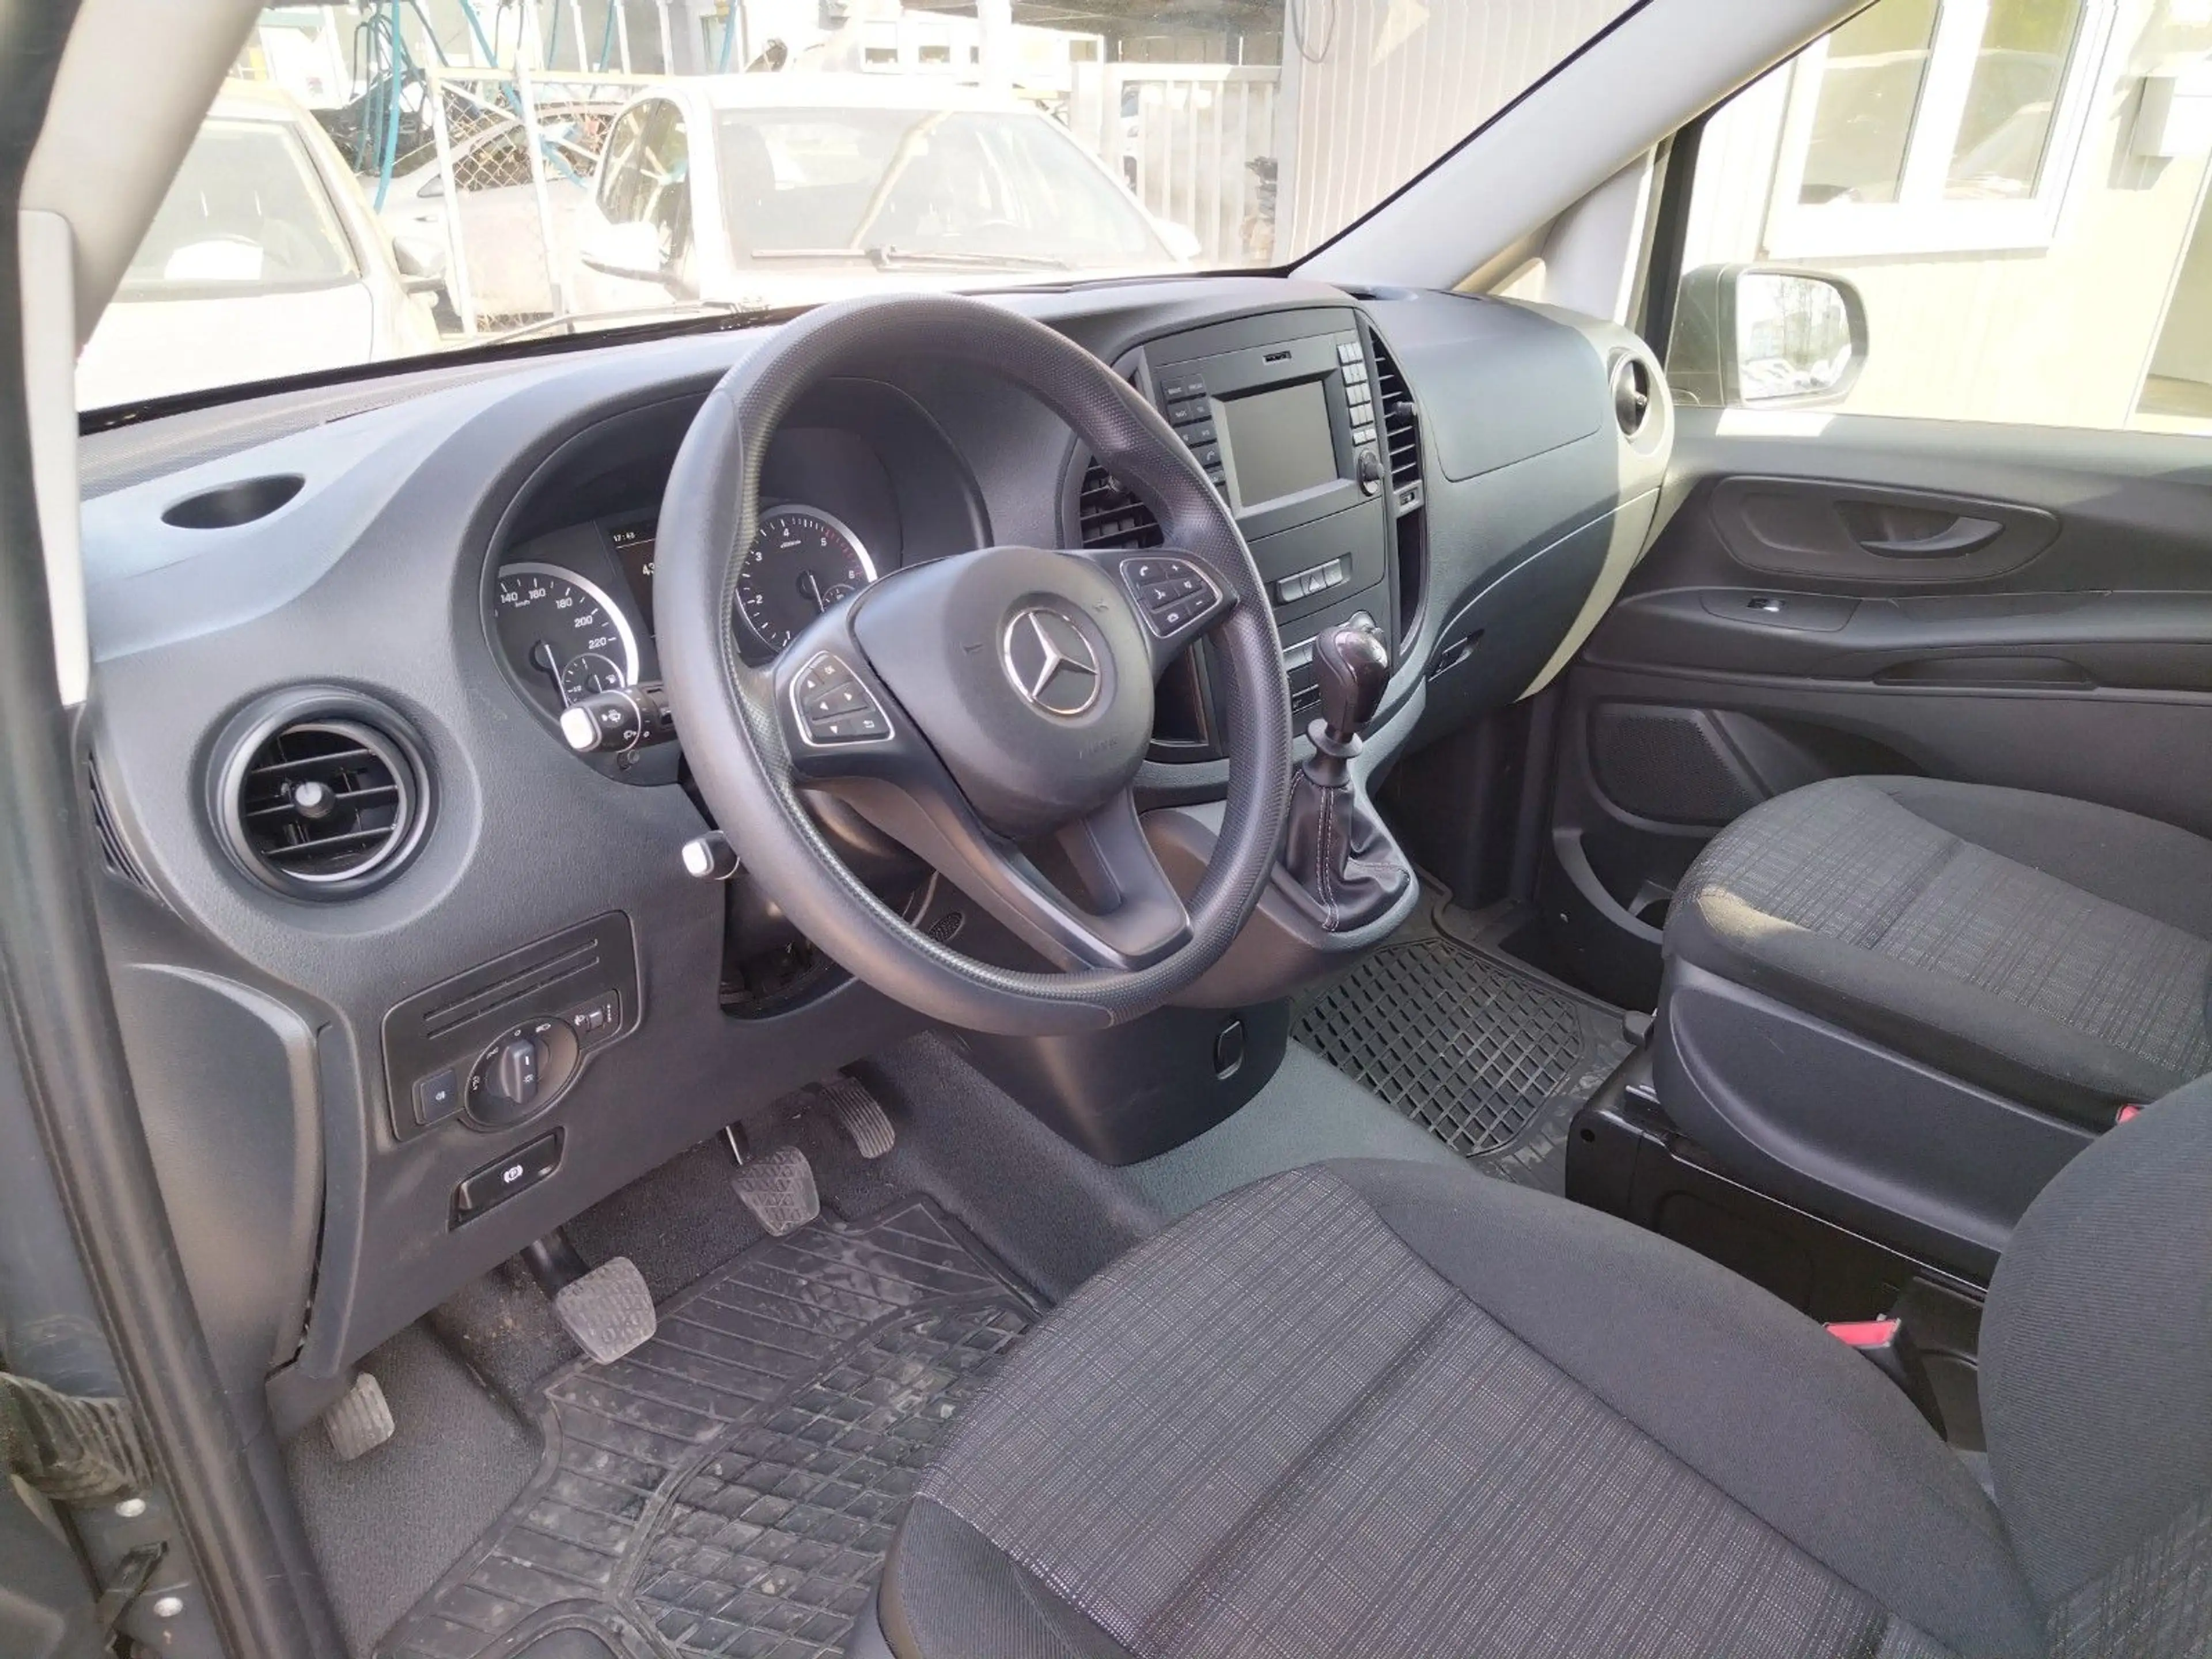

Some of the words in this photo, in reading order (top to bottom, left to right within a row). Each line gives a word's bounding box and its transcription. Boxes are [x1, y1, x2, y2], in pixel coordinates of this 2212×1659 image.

[783, 528, 789, 537] 4
[755, 551, 763, 562] 3
[501, 592, 518, 604] 140
[555, 597, 573, 609] 180
[756, 594, 763, 604] 2
[574, 615, 593, 628] 200
[589, 637, 607, 650] 220
